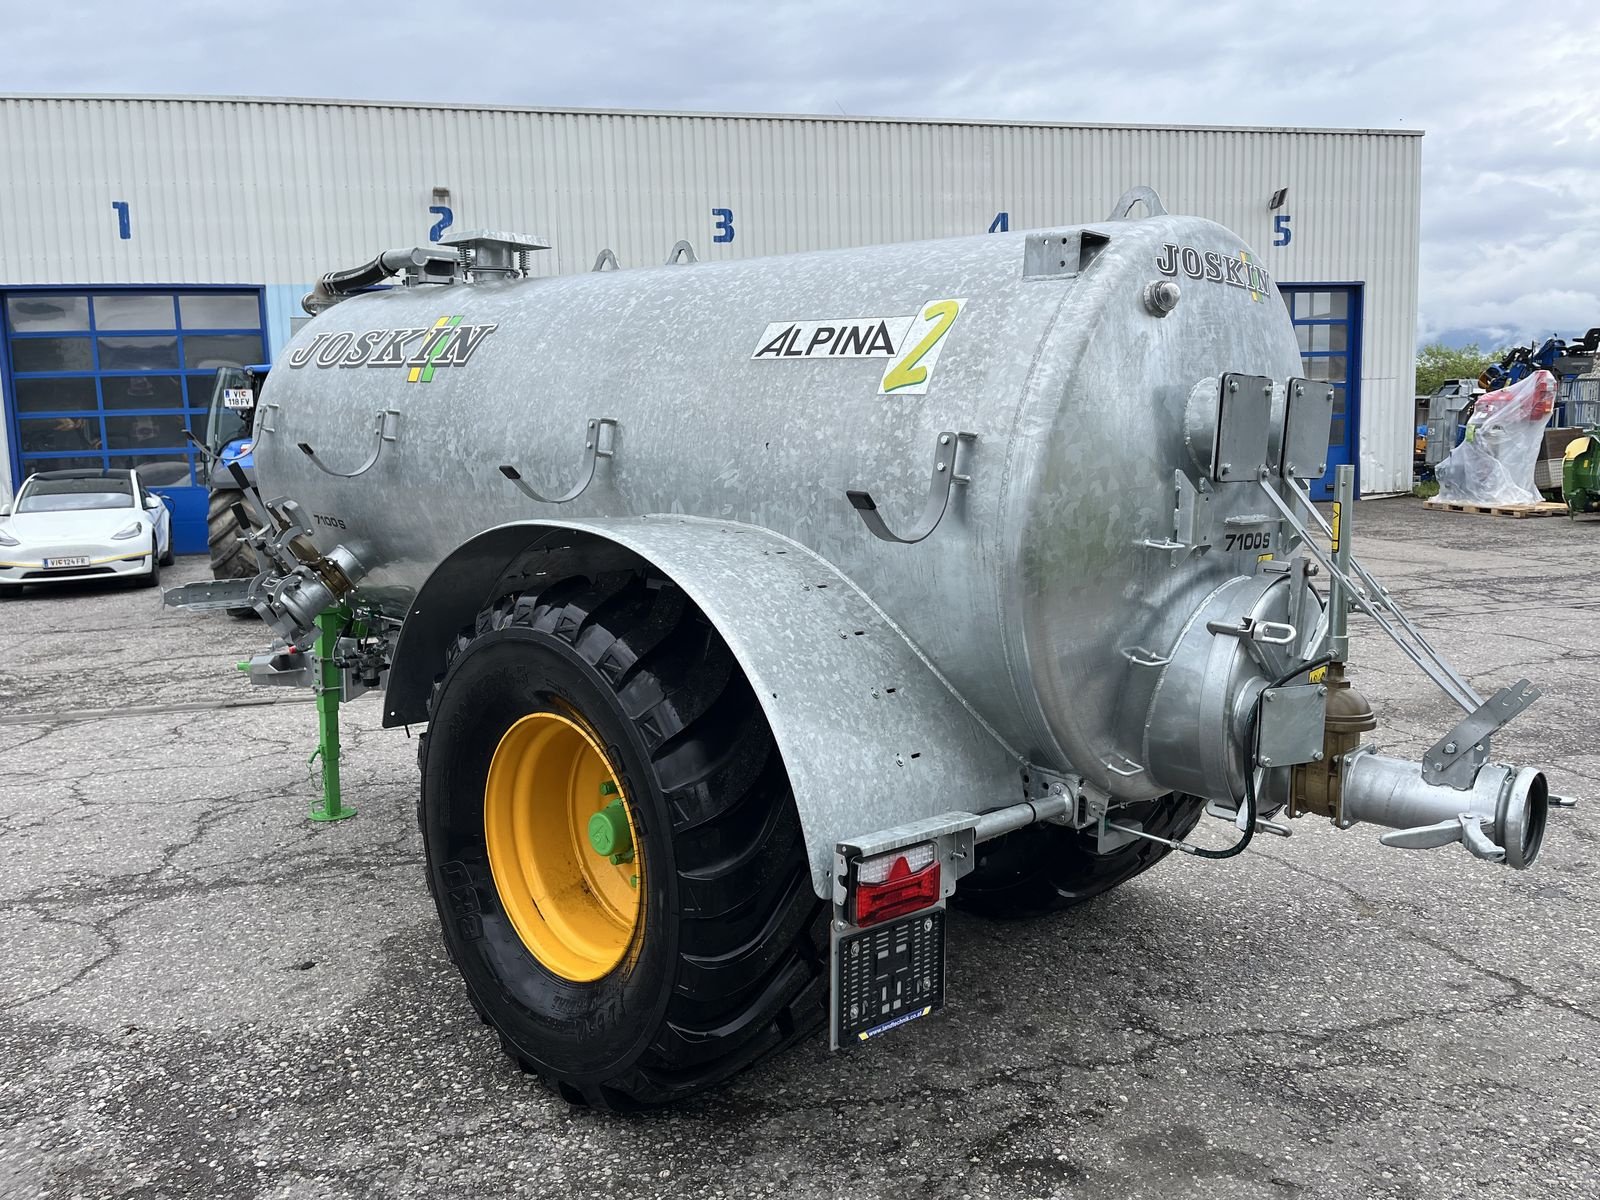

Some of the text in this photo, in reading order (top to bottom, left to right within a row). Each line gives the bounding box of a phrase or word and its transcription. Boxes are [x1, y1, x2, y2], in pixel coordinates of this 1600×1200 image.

[112, 201, 131, 239] 1
[429, 206, 453, 242] 2
[712, 208, 735, 243] 3
[1273, 215, 1292, 247] 5
[1156, 243, 1271, 298] JOSKIN
[289, 323, 499, 369] JOSKIN
[754, 300, 960, 393] ALPINA 2
[1225, 532, 1271, 552] 7100S
